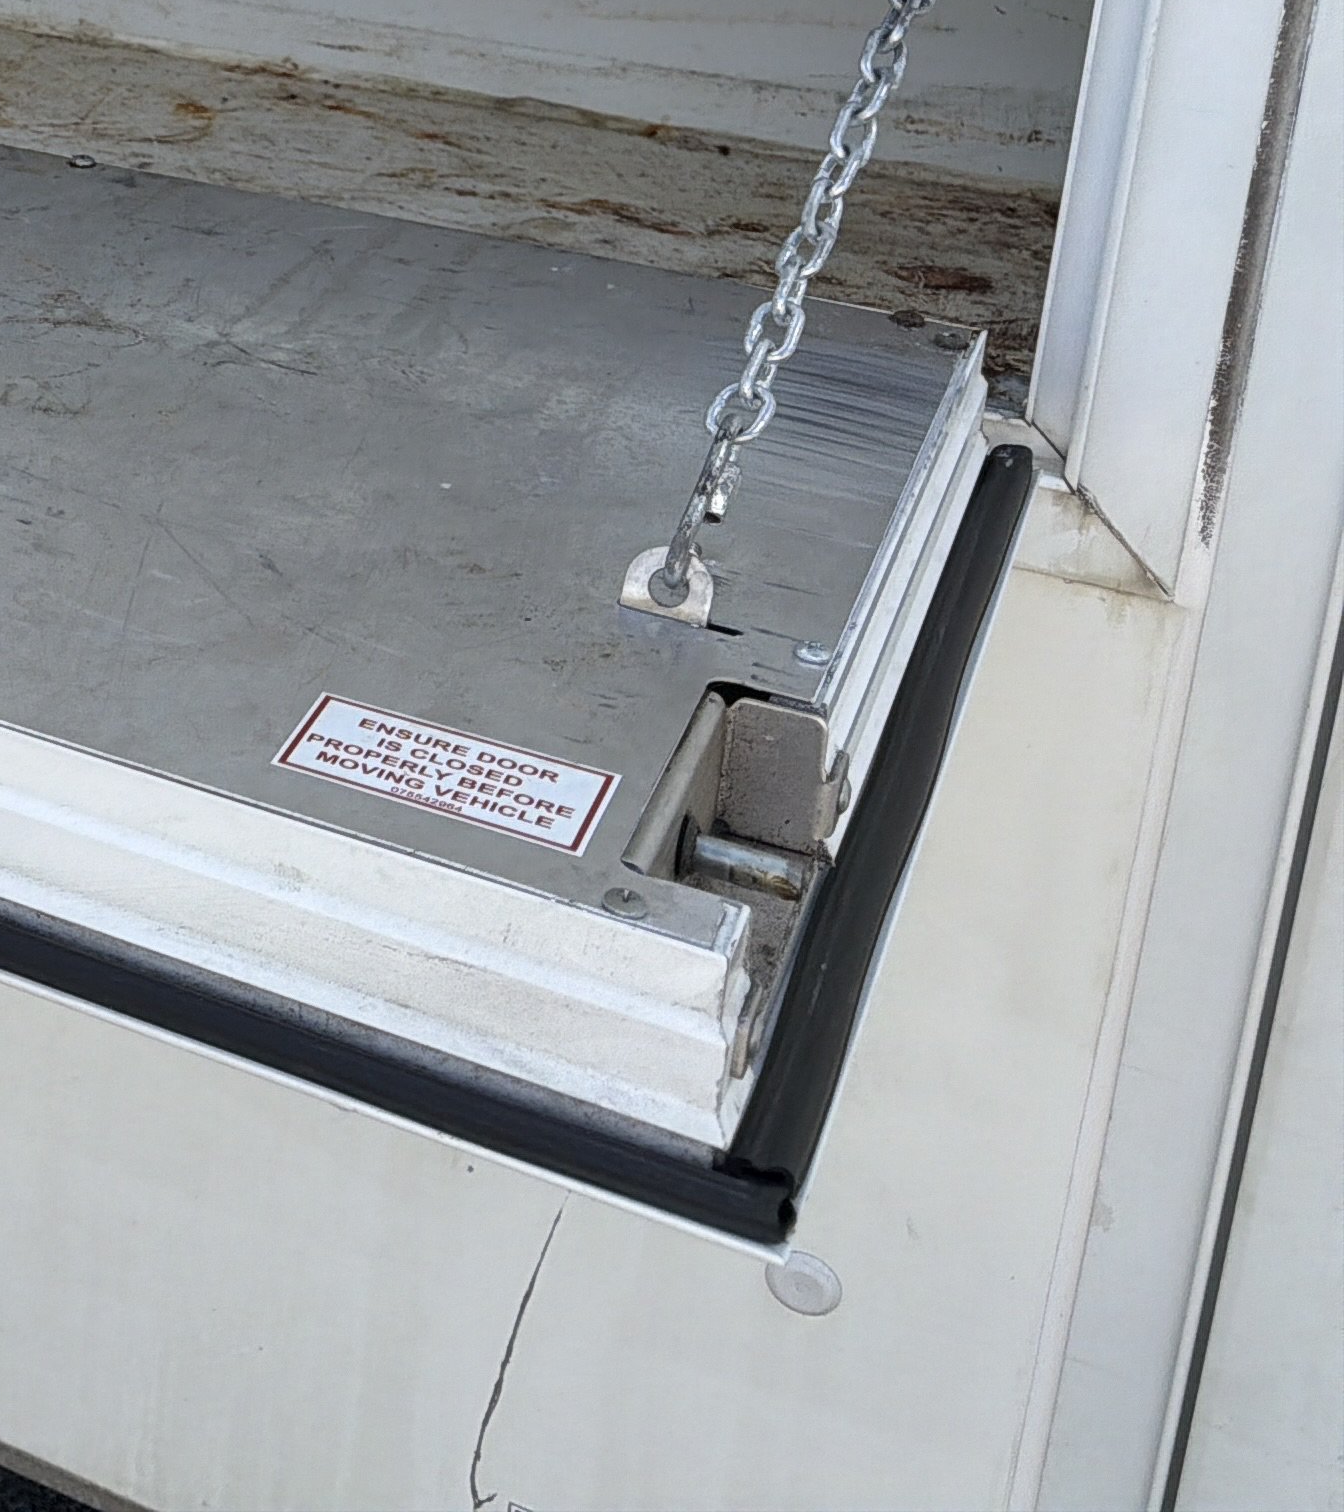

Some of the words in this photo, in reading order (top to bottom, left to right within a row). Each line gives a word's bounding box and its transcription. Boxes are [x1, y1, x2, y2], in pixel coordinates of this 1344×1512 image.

[306, 732, 453, 781] PROPERLY
[457, 776, 576, 819] BEFORE
[358, 717, 471, 757] ENSURE
[476, 751, 560, 783] DOOR
[377, 738, 403, 752] IS
[410, 748, 523, 787] CLOSED
[315, 750, 426, 790] MOVING
[434, 785, 556, 829] VEHICLE
